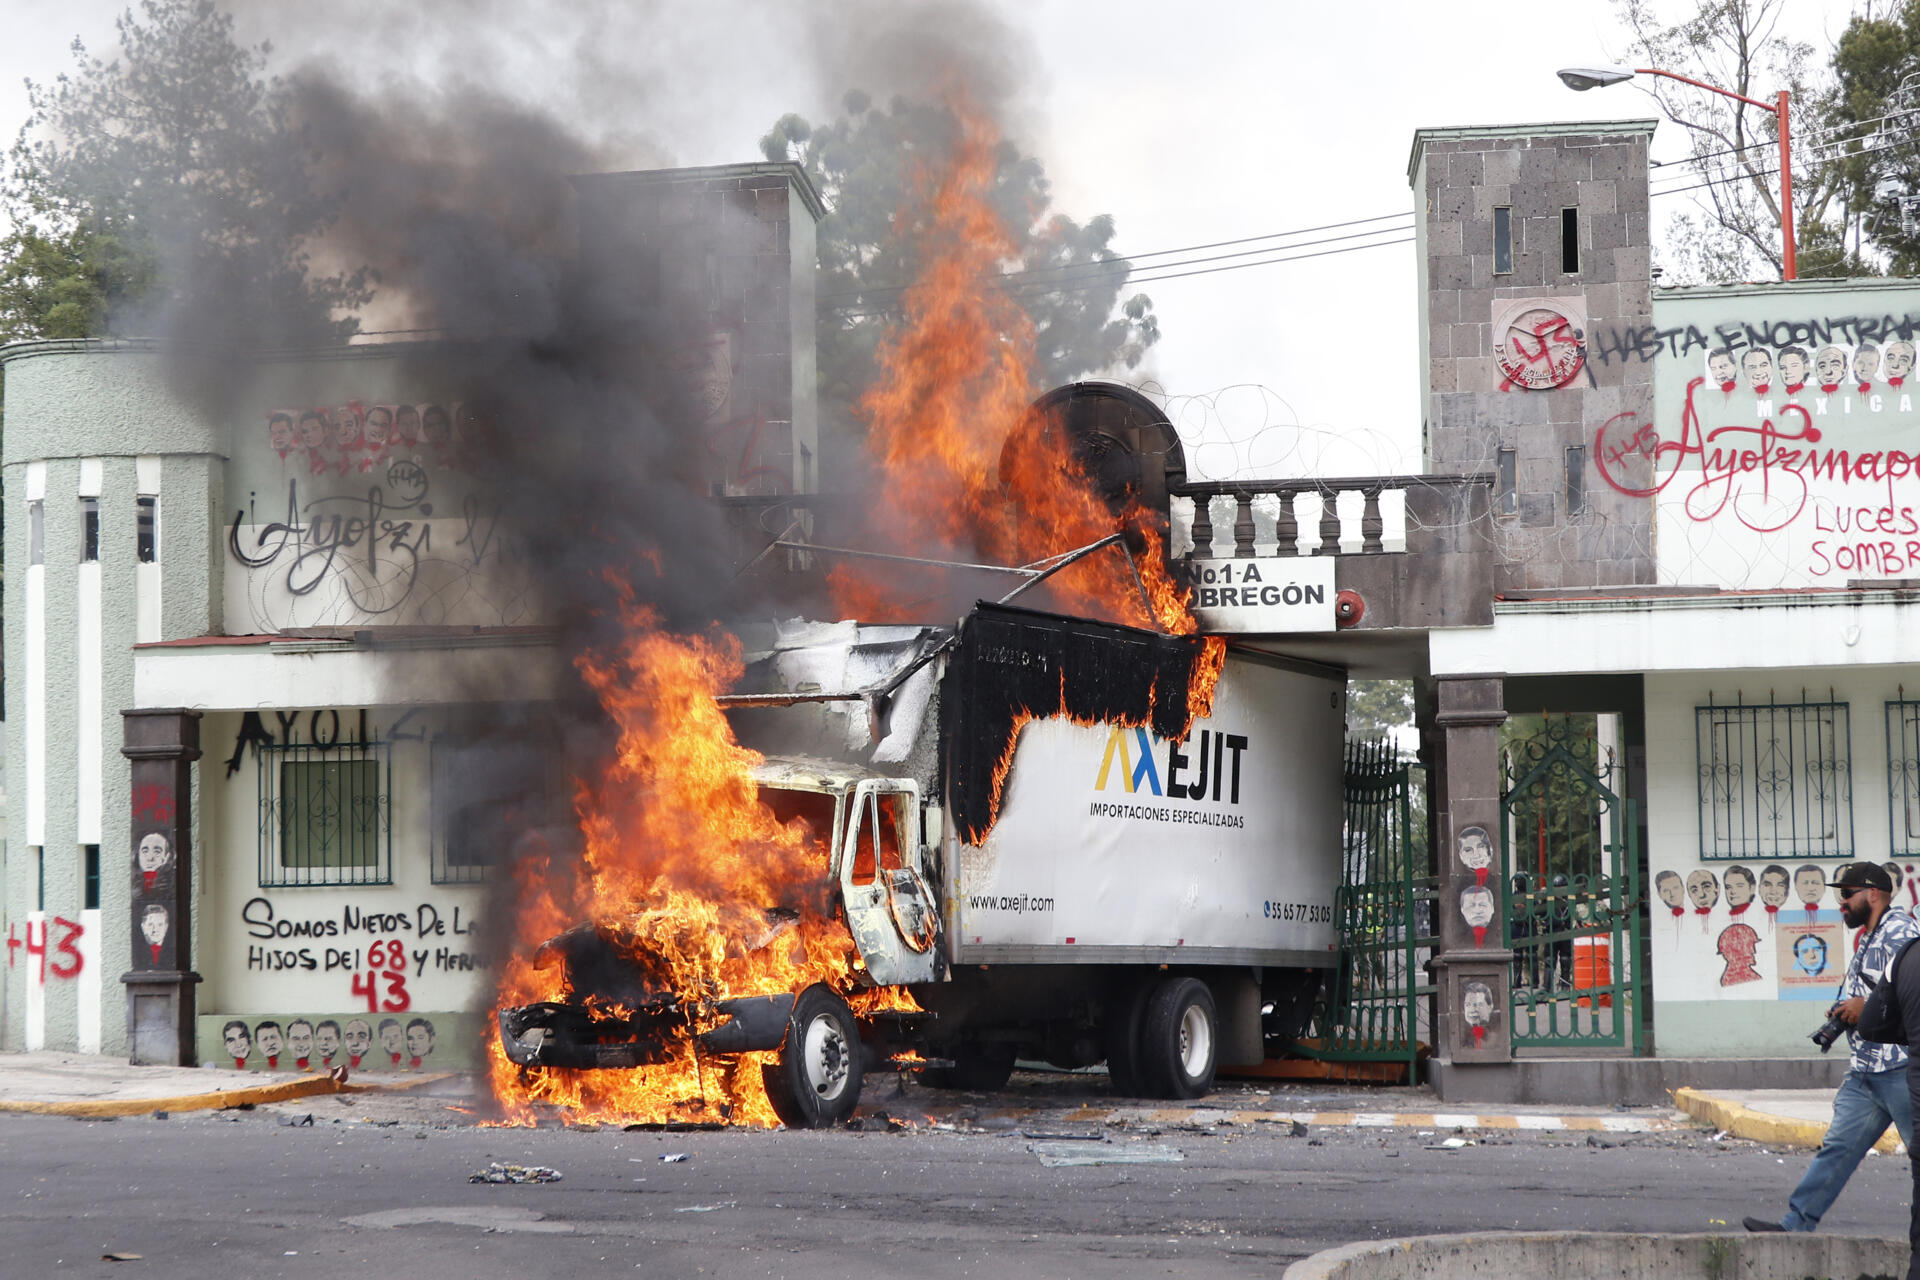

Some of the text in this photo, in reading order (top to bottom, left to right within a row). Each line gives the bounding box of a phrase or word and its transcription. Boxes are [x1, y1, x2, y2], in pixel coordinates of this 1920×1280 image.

[1594, 377, 1920, 532] Ayotzinap
[1089, 802, 1244, 829] IMPORTACIONES ESPECIALIZADAS
[970, 892, 1055, 915] www.axejit.com
[1272, 902, 1331, 922] 55 65 77 53 05
[367, 939, 407, 971] 68
[351, 970, 411, 1013] 43
